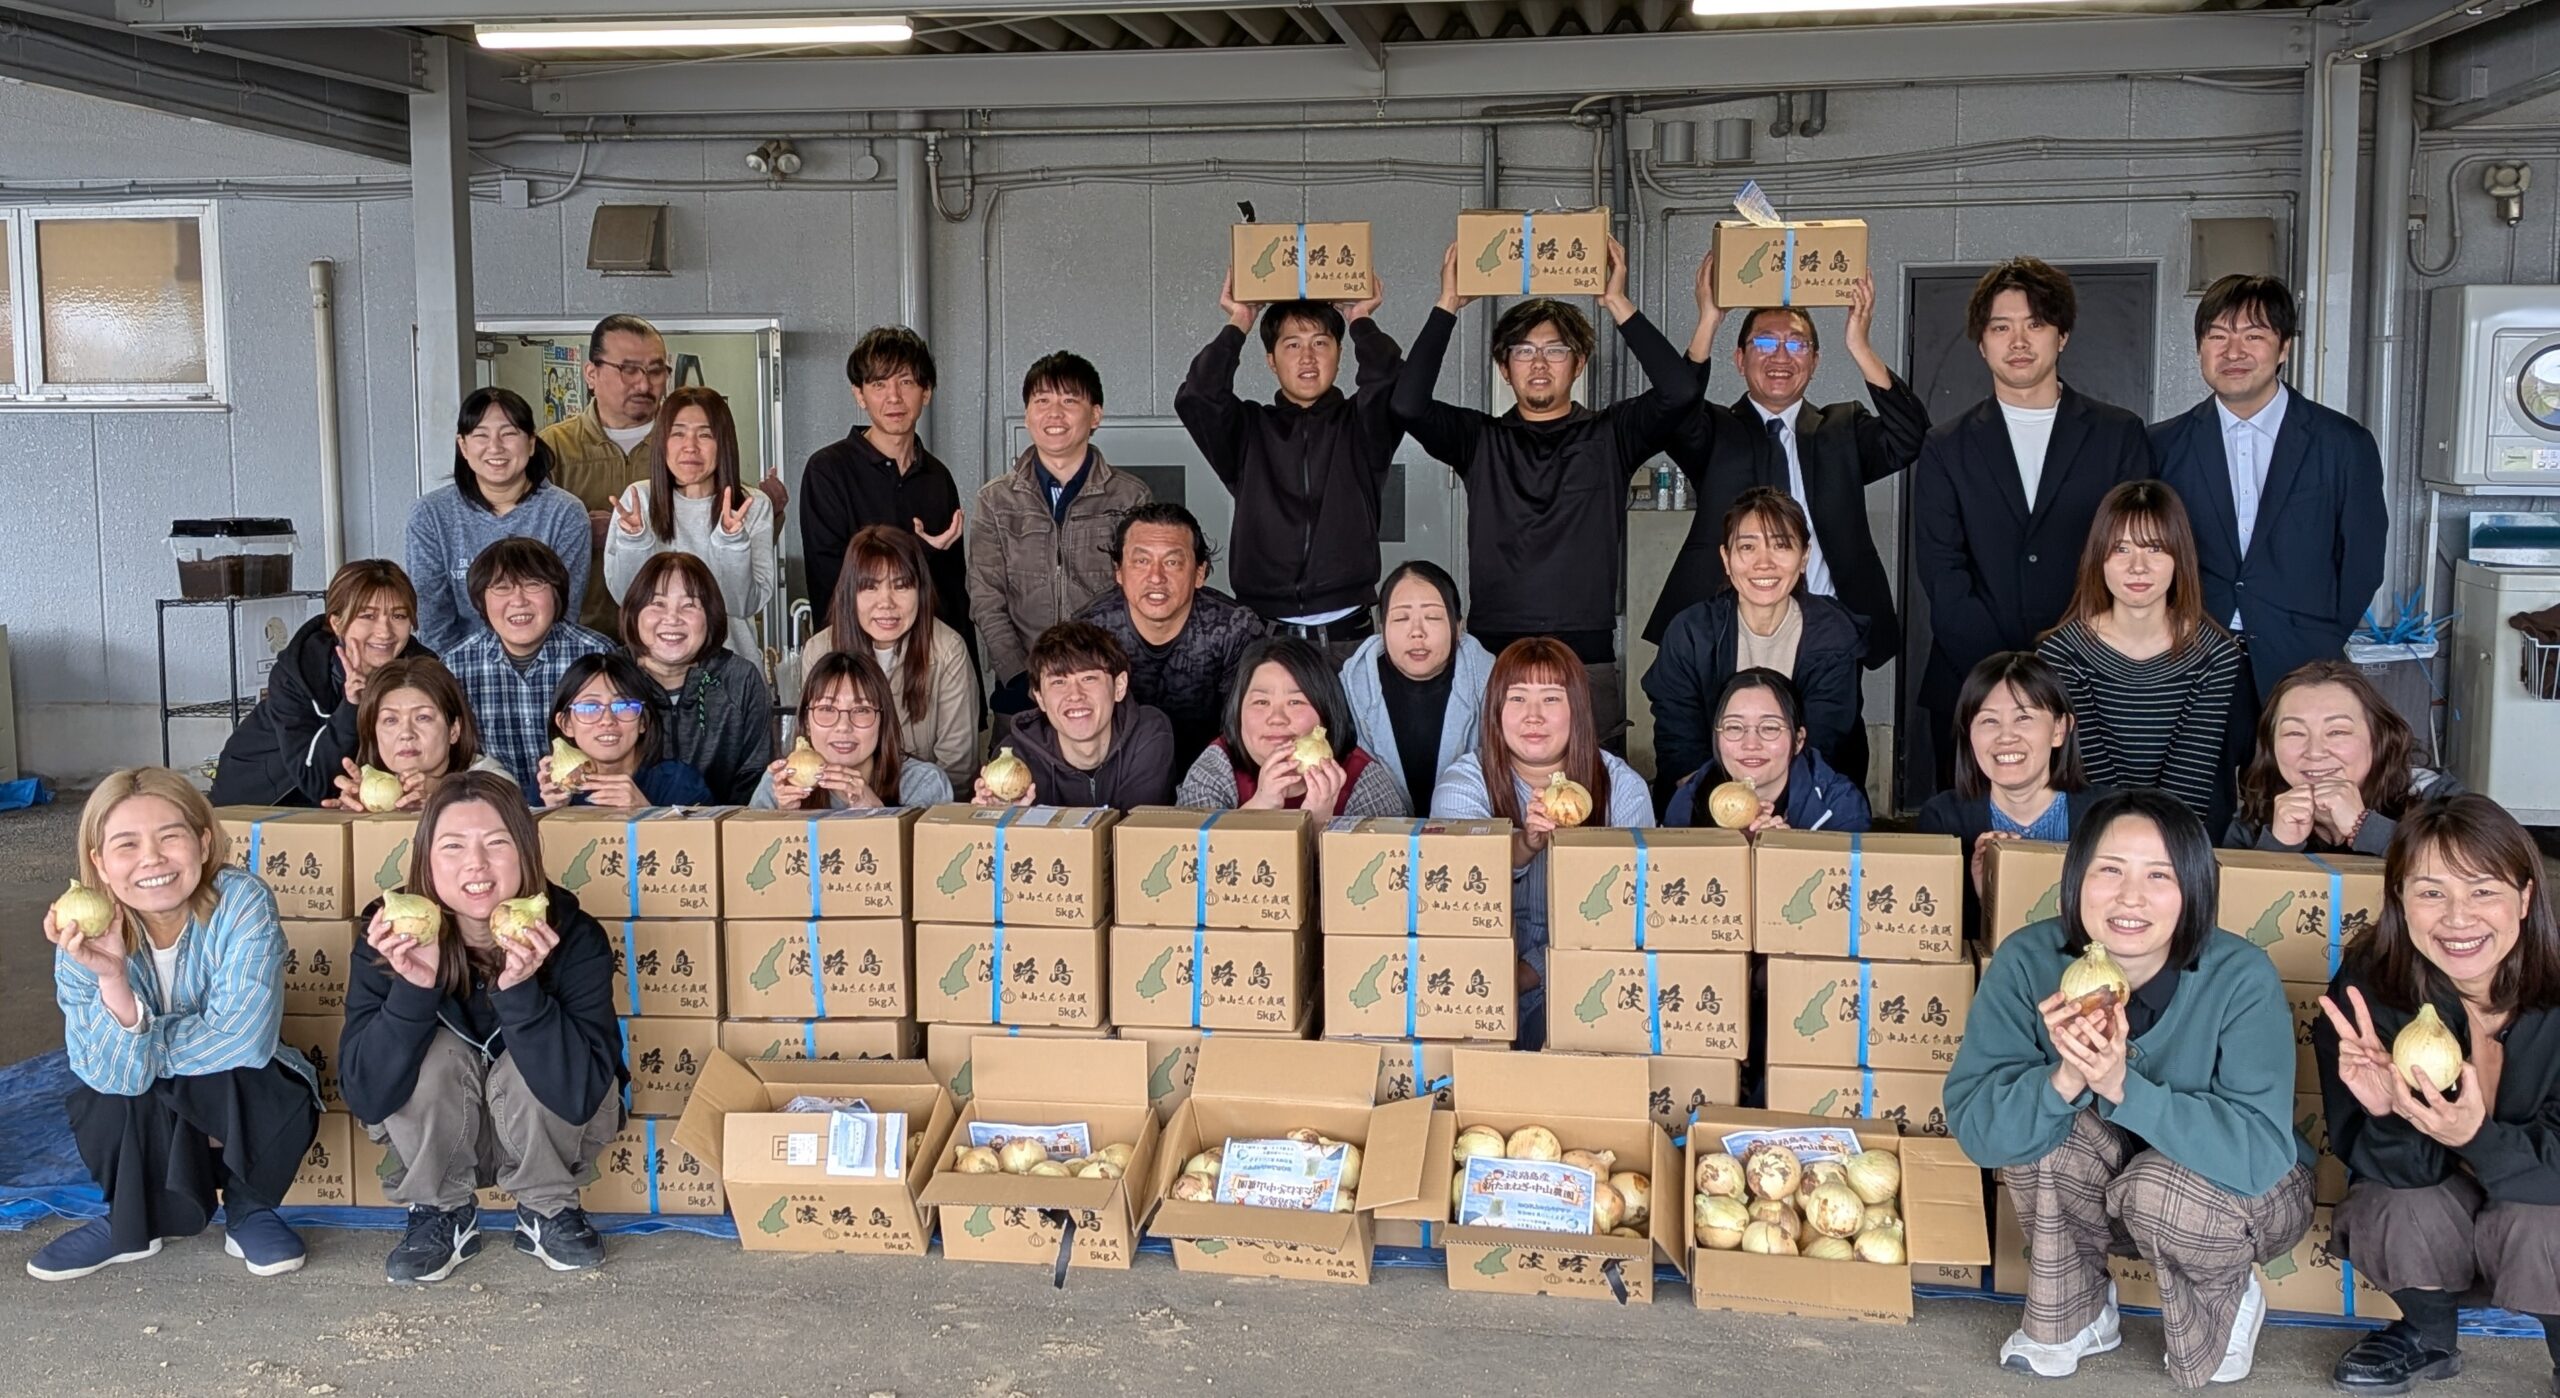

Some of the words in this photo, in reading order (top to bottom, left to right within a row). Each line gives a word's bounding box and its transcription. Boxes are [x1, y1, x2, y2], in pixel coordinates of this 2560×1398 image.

[1344, 282, 1366, 292] 5kg入
[1574, 278, 1598, 287] 5kg入
[600, 850, 695, 877] 淡路島
[785, 848, 879, 876] 淡路島
[976, 856, 1071, 887] 淡路島
[1388, 864, 1489, 895] 淡路島
[308, 900, 334, 910] 5kg入
[680, 897, 709, 908] 5kg入
[865, 896, 893, 907] 5kg入
[1827, 882, 1938, 917] 淡路島
[1055, 907, 1084, 919] 5kg入
[1261, 909, 1290, 920] 5kg入
[1473, 916, 1504, 927] 5kg入
[1711, 929, 1744, 941] 5kg入
[1919, 940, 1953, 952] 5kg入
[789, 949, 883, 977] 淡路島
[319, 996, 346, 1008] 5kg入
[680, 997, 709, 1008] 5kg入
[868, 997, 897, 1008] 5kg入
[1617, 982, 1723, 1015] 淡路島
[1058, 1006, 1087, 1018] 5kg入
[1256, 1009, 1286, 1022] 5kg入
[1475, 1019, 1506, 1031] 5kg入
[1705, 1037, 1737, 1049] 5kg入
[640, 1048, 698, 1076] 路島
[1931, 1050, 1953, 1062] 5kg
[317, 1188, 345, 1199] 5kg入
[688, 1196, 716, 1207] 5kg入
[796, 1205, 893, 1228] 淡路島
[884, 1241, 914, 1250] 5kg入
[1090, 1251, 1121, 1262] 5kg入
[1326, 1269, 1358, 1279] 5kg入
[1939, 1267, 1973, 1280] 5kg入
